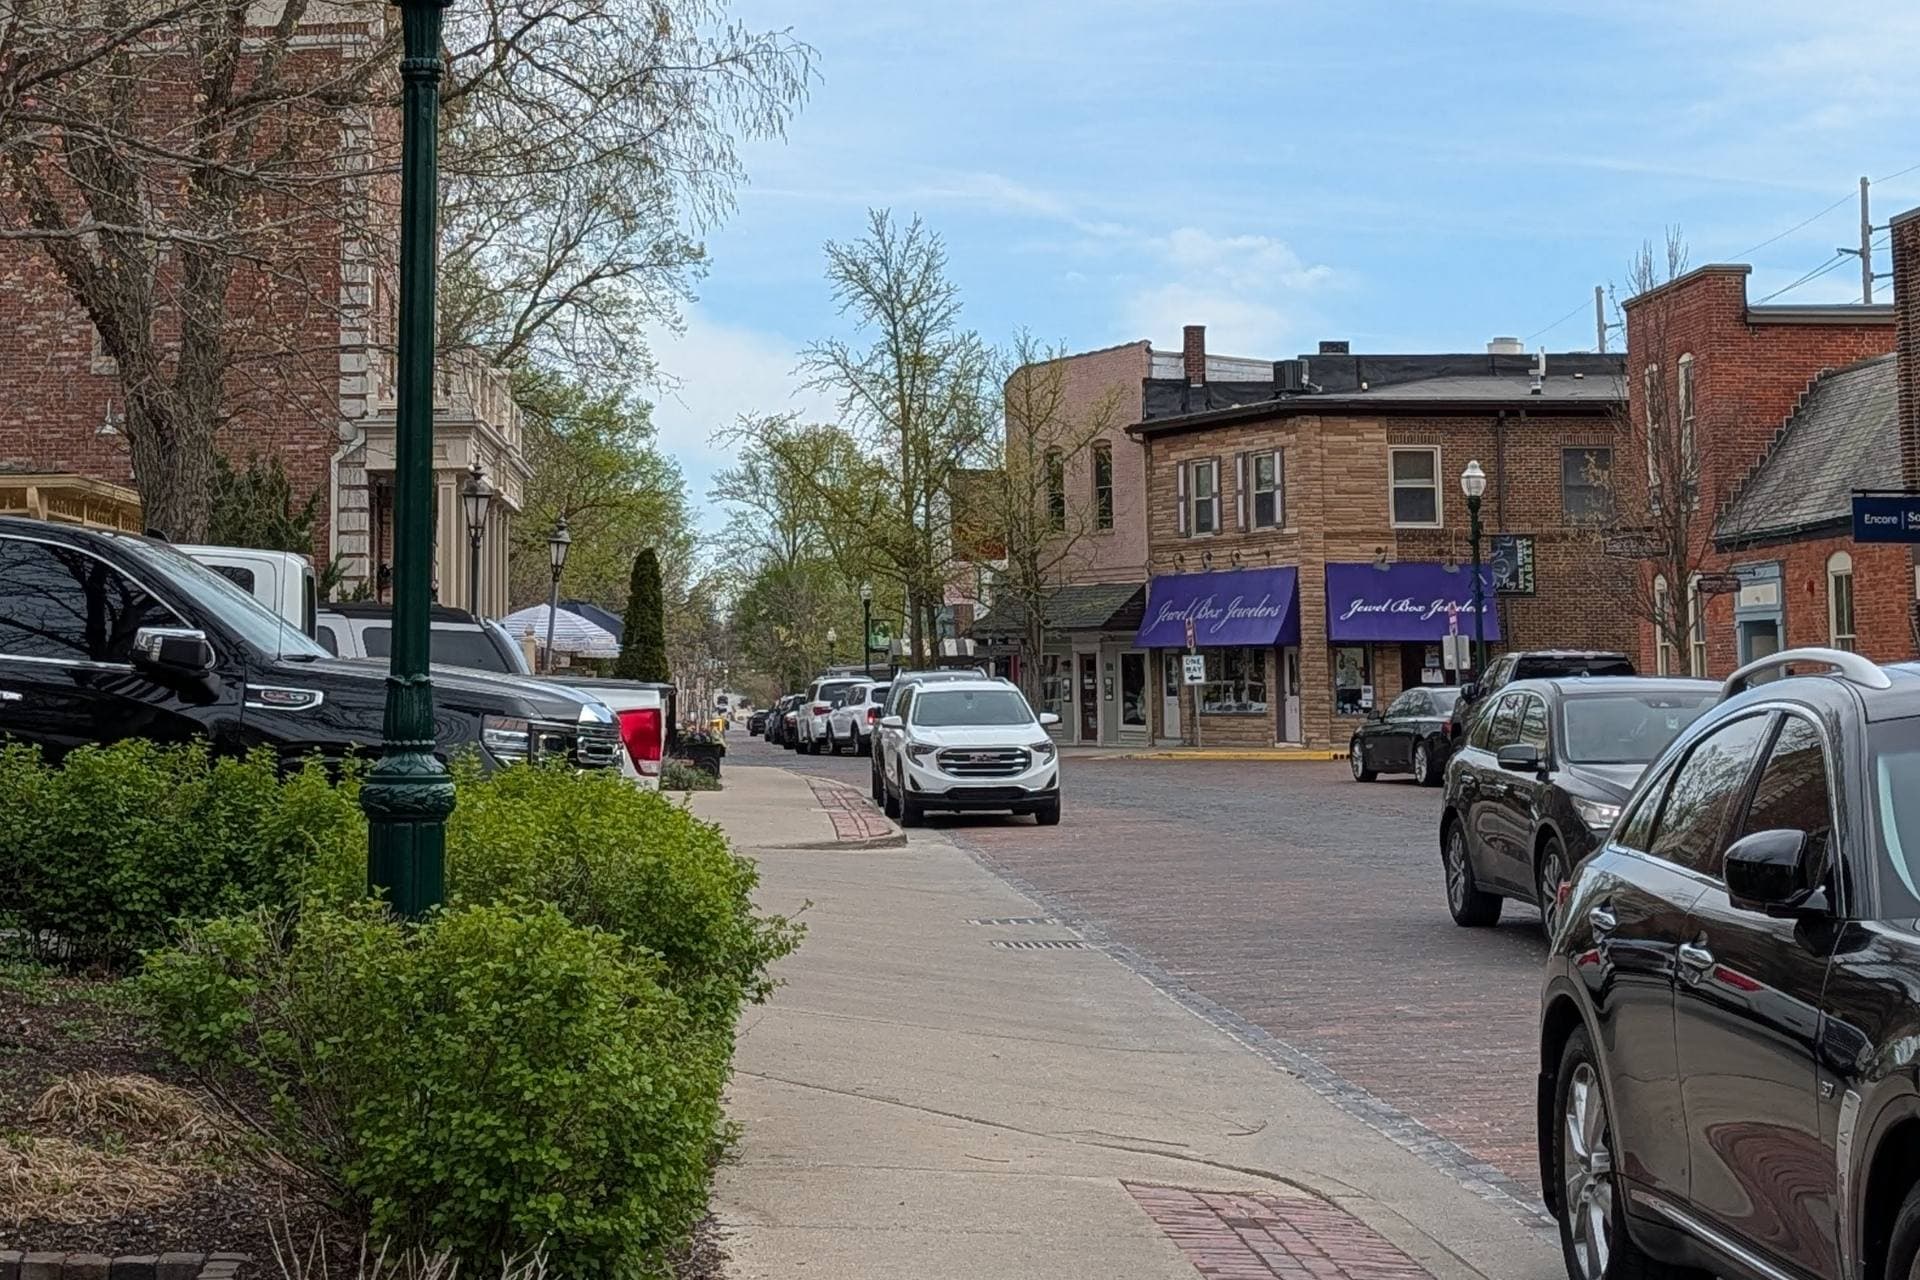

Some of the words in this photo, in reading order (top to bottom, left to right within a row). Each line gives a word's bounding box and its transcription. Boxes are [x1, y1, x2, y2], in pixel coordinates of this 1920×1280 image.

[1864, 513, 1898, 525] Encore
[1522, 538, 1534, 592] MARKET
[1142, 597, 1198, 637] Jewel
[1191, 593, 1223, 620] Box
[1210, 593, 1282, 634] Jewelers
[1339, 598, 1393, 621] Jewel
[1390, 597, 1426, 613] Box
[1185, 657, 1201, 666] ONE
[1185, 666, 1202, 674] WAY
